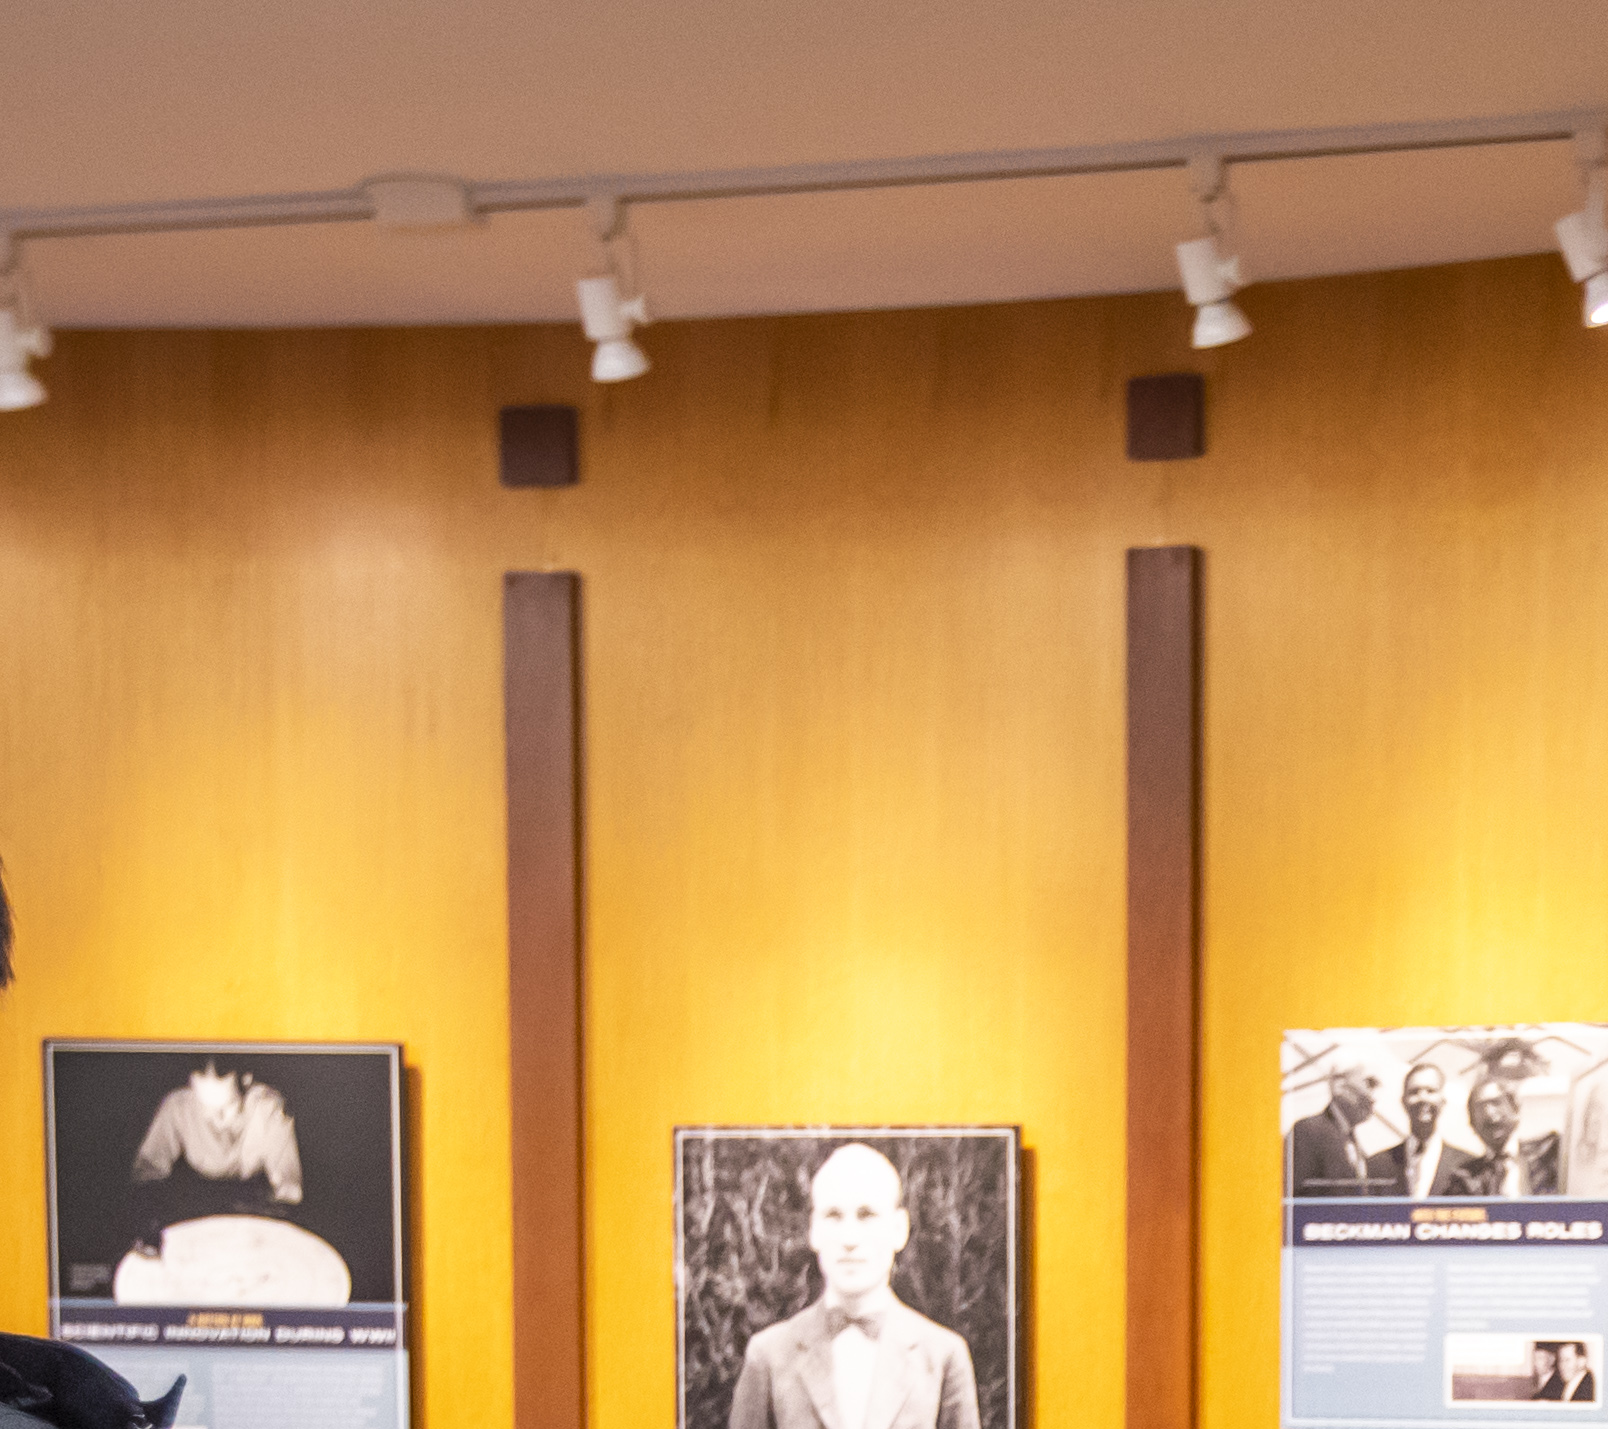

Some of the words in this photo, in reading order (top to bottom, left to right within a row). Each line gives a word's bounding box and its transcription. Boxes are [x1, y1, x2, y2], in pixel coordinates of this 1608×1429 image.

[1303, 1222, 1411, 1241] BECKMAN
[1414, 1221, 1522, 1240] CHANGES
[1526, 1221, 1603, 1240] ROLES
[274, 1326, 345, 1343] DURING
